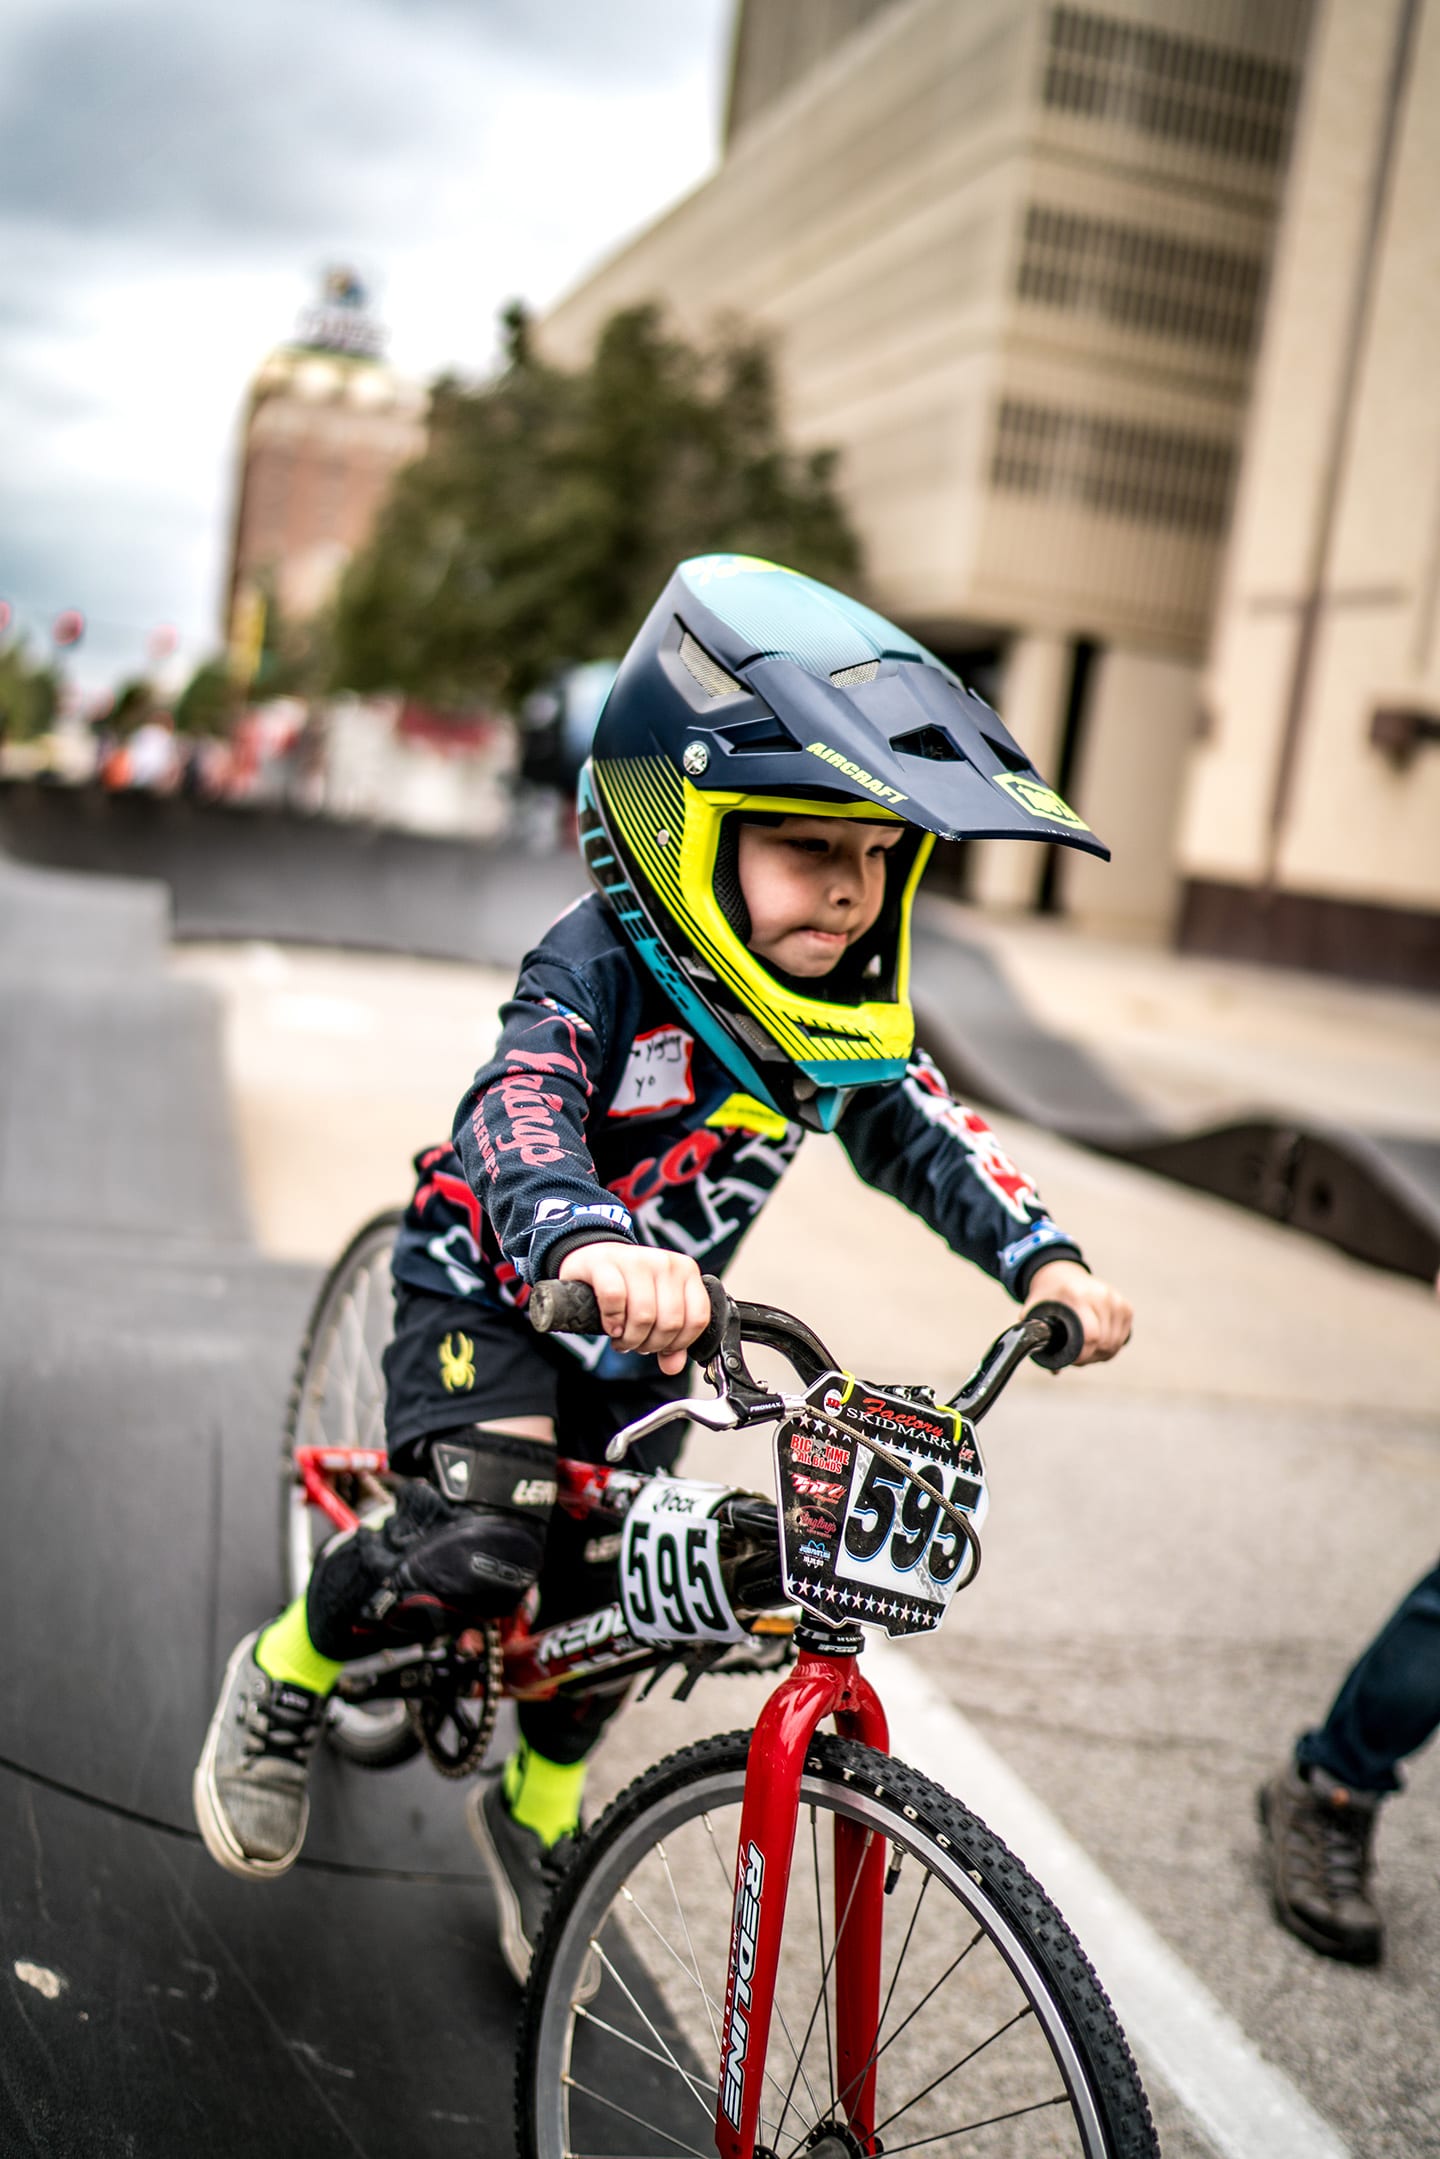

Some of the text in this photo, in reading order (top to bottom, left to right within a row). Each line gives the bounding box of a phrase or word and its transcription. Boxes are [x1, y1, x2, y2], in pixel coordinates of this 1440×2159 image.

[805, 741, 909, 804] AIRCRAFT
[846, 1407, 952, 1450] SKIDMARK
[863, 1397, 944, 1437] Factory
[790, 1433, 851, 1466] BIG TIME
[812, 1455, 843, 1475] BONDS
[844, 1455, 983, 1585] 595
[627, 1520, 729, 1635] 595
[843, 1767, 984, 1886] TIOGA
[722, 1840, 766, 2133] REDLINE
